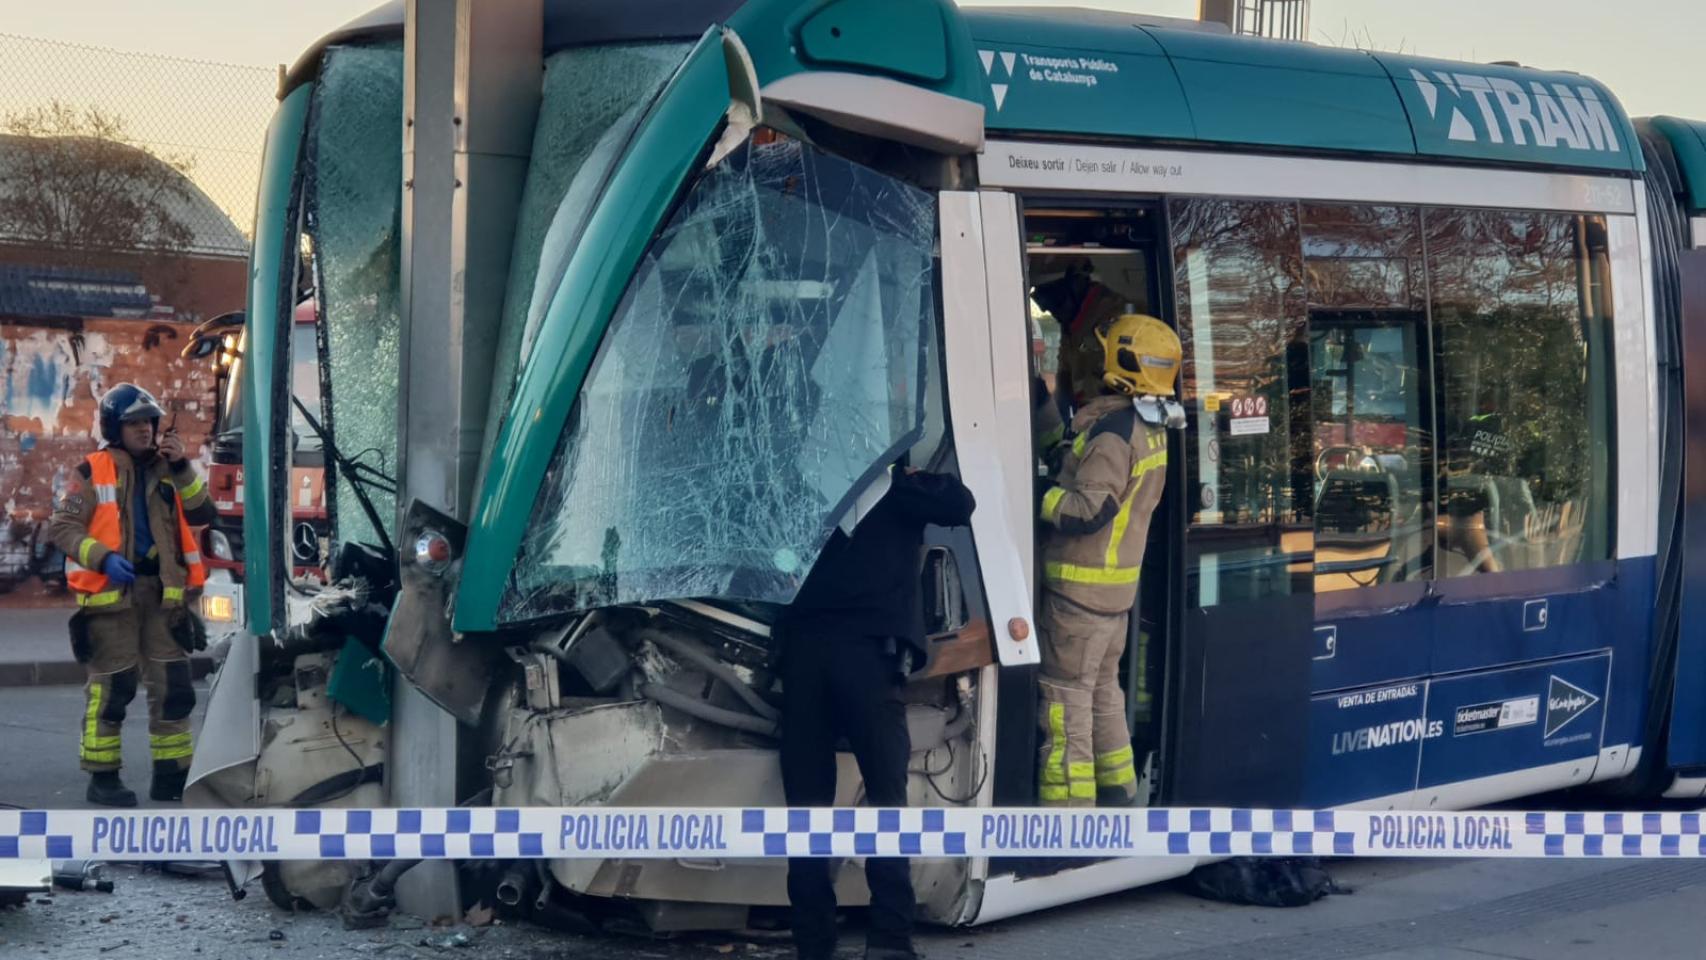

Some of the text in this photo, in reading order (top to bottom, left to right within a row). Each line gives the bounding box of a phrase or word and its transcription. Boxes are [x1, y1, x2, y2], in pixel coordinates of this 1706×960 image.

[1029, 69, 1097, 87] de Catalunya
[1453, 73, 1620, 152] TRAM
[1008, 155, 1039, 170] Deixeu
[1042, 158, 1065, 171] sortir
[1076, 158, 1099, 174] Dejen
[1101, 160, 1117, 173] salir
[1130, 161, 1149, 174] Allow
[1153, 163, 1168, 177] way
[1170, 164, 1182, 176] out
[1338, 685, 1418, 708] VENTA DE ENTRADAS:
[92, 815, 279, 853] POLICIA LOCAL
[560, 814, 727, 850] POLICIA LOCAL
[981, 814, 1134, 849] POLICIA LOCAL
[1368, 815, 1513, 850] POLICIA LOCAL
